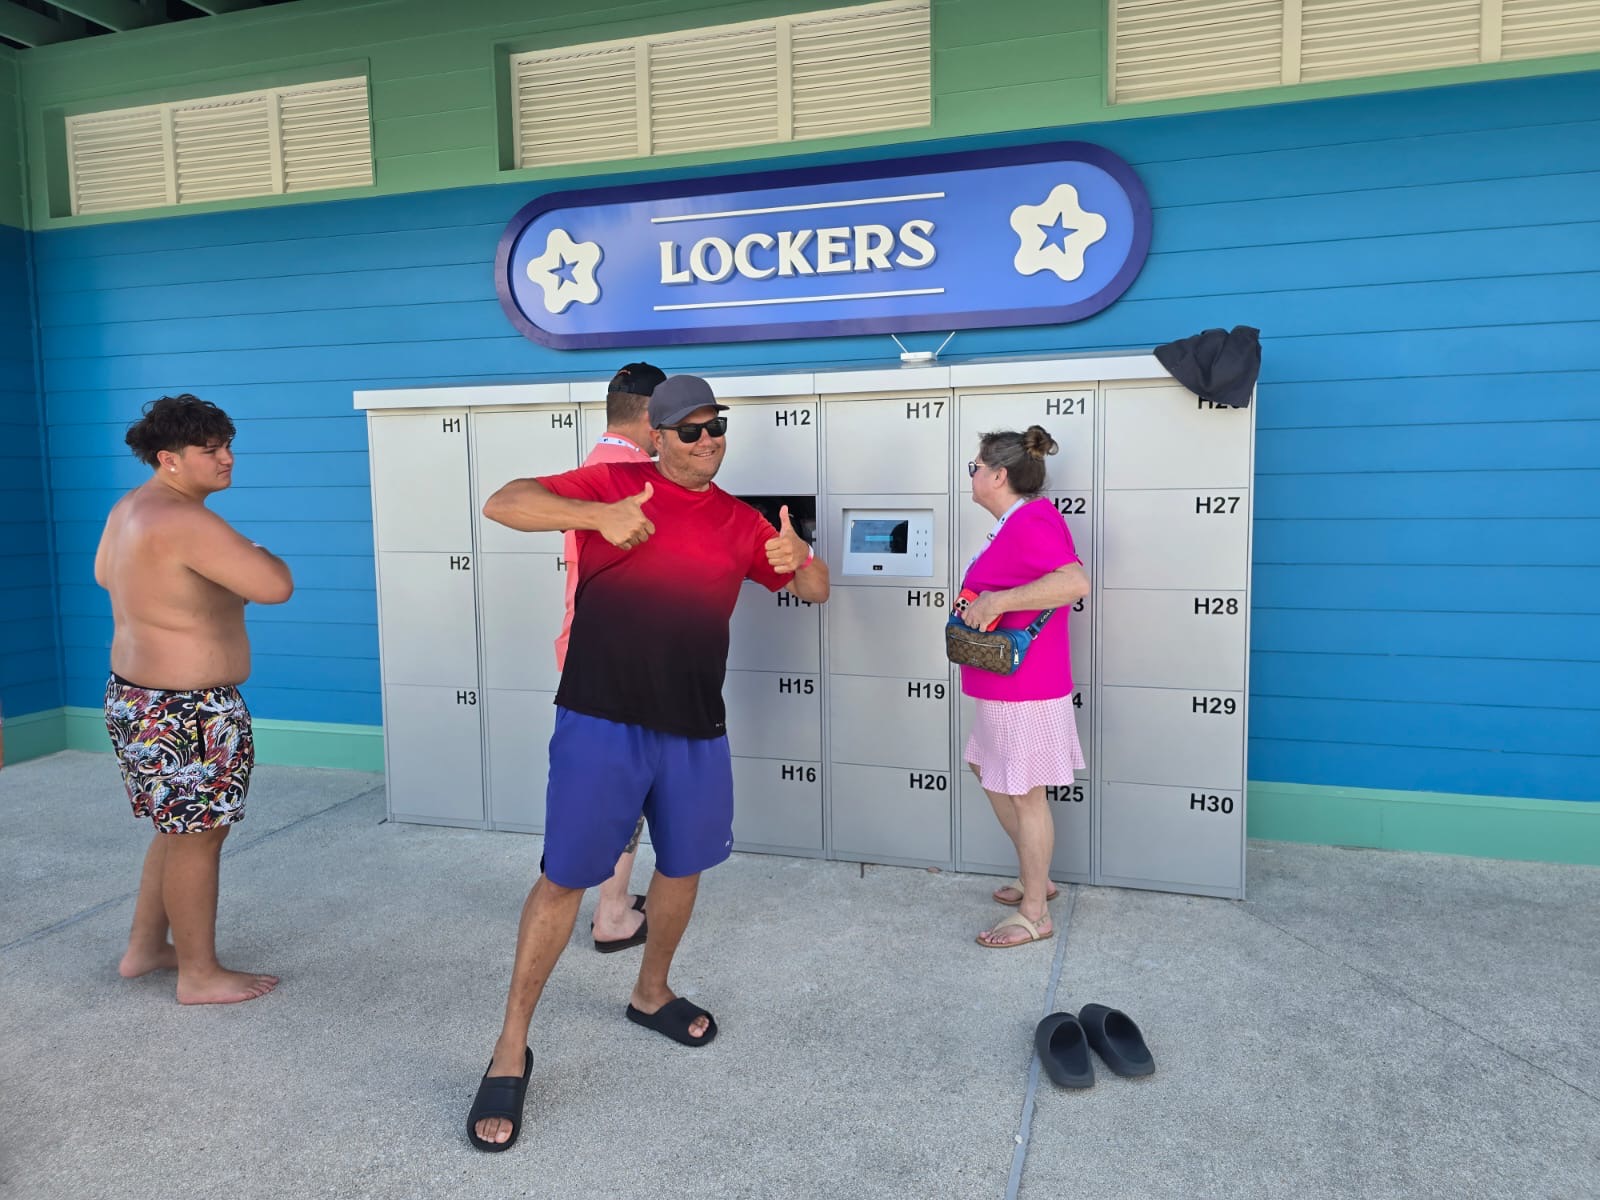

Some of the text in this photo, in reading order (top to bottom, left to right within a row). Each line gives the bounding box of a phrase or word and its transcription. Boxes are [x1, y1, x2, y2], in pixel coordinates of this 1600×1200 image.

[659, 219, 936, 285] LOCKERS
[906, 402, 944, 419] H17
[1046, 398, 1085, 416] H21
[442, 418, 460, 433] H1
[551, 413, 573, 429] H4
[775, 409, 811, 427] H12
[1195, 497, 1241, 514] H27
[450, 556, 470, 570] H2
[557, 557, 568, 571] H
[907, 590, 945, 608] H18
[1194, 597, 1238, 615] H28
[779, 678, 814, 695] H15
[907, 682, 945, 699] H19
[456, 691, 477, 705] H3
[1192, 697, 1236, 715] H29
[781, 765, 817, 783] H16
[909, 773, 947, 791] H20
[1046, 785, 1084, 802] H25
[1190, 793, 1234, 814] H30
